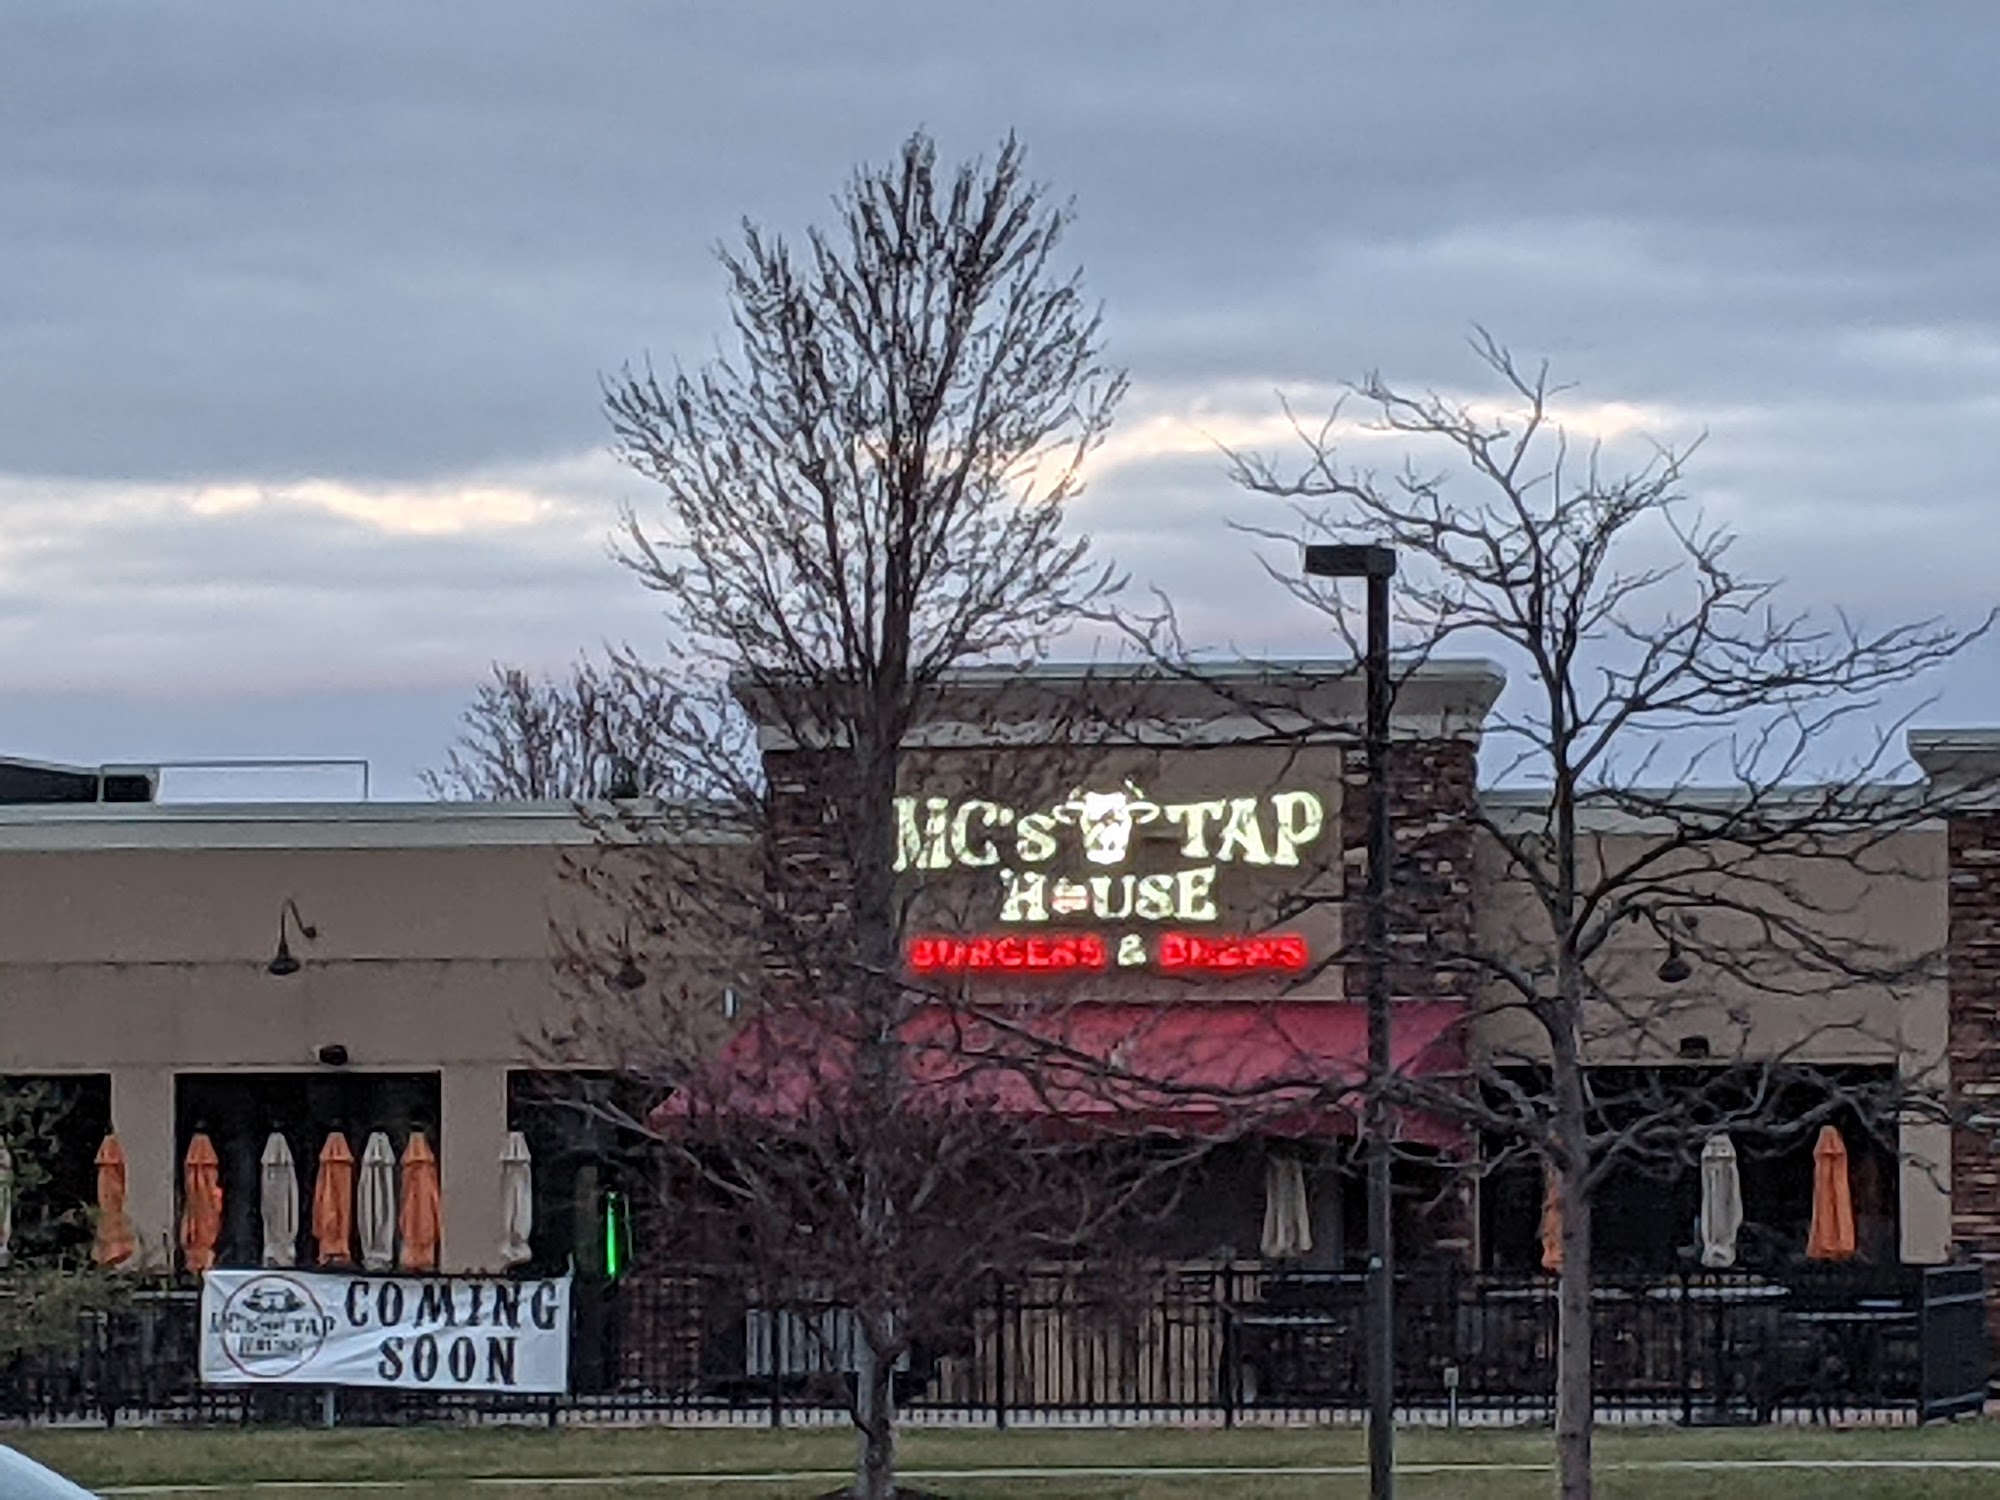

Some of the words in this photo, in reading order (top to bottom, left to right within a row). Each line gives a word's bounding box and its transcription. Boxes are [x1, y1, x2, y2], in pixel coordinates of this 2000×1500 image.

[1165, 790, 1324, 867] TAP
[999, 865, 1218, 921] HOUSE
[1117, 933, 1147, 967] &
[344, 1279, 561, 1330] COMING
[378, 1336, 517, 1386] SOON
